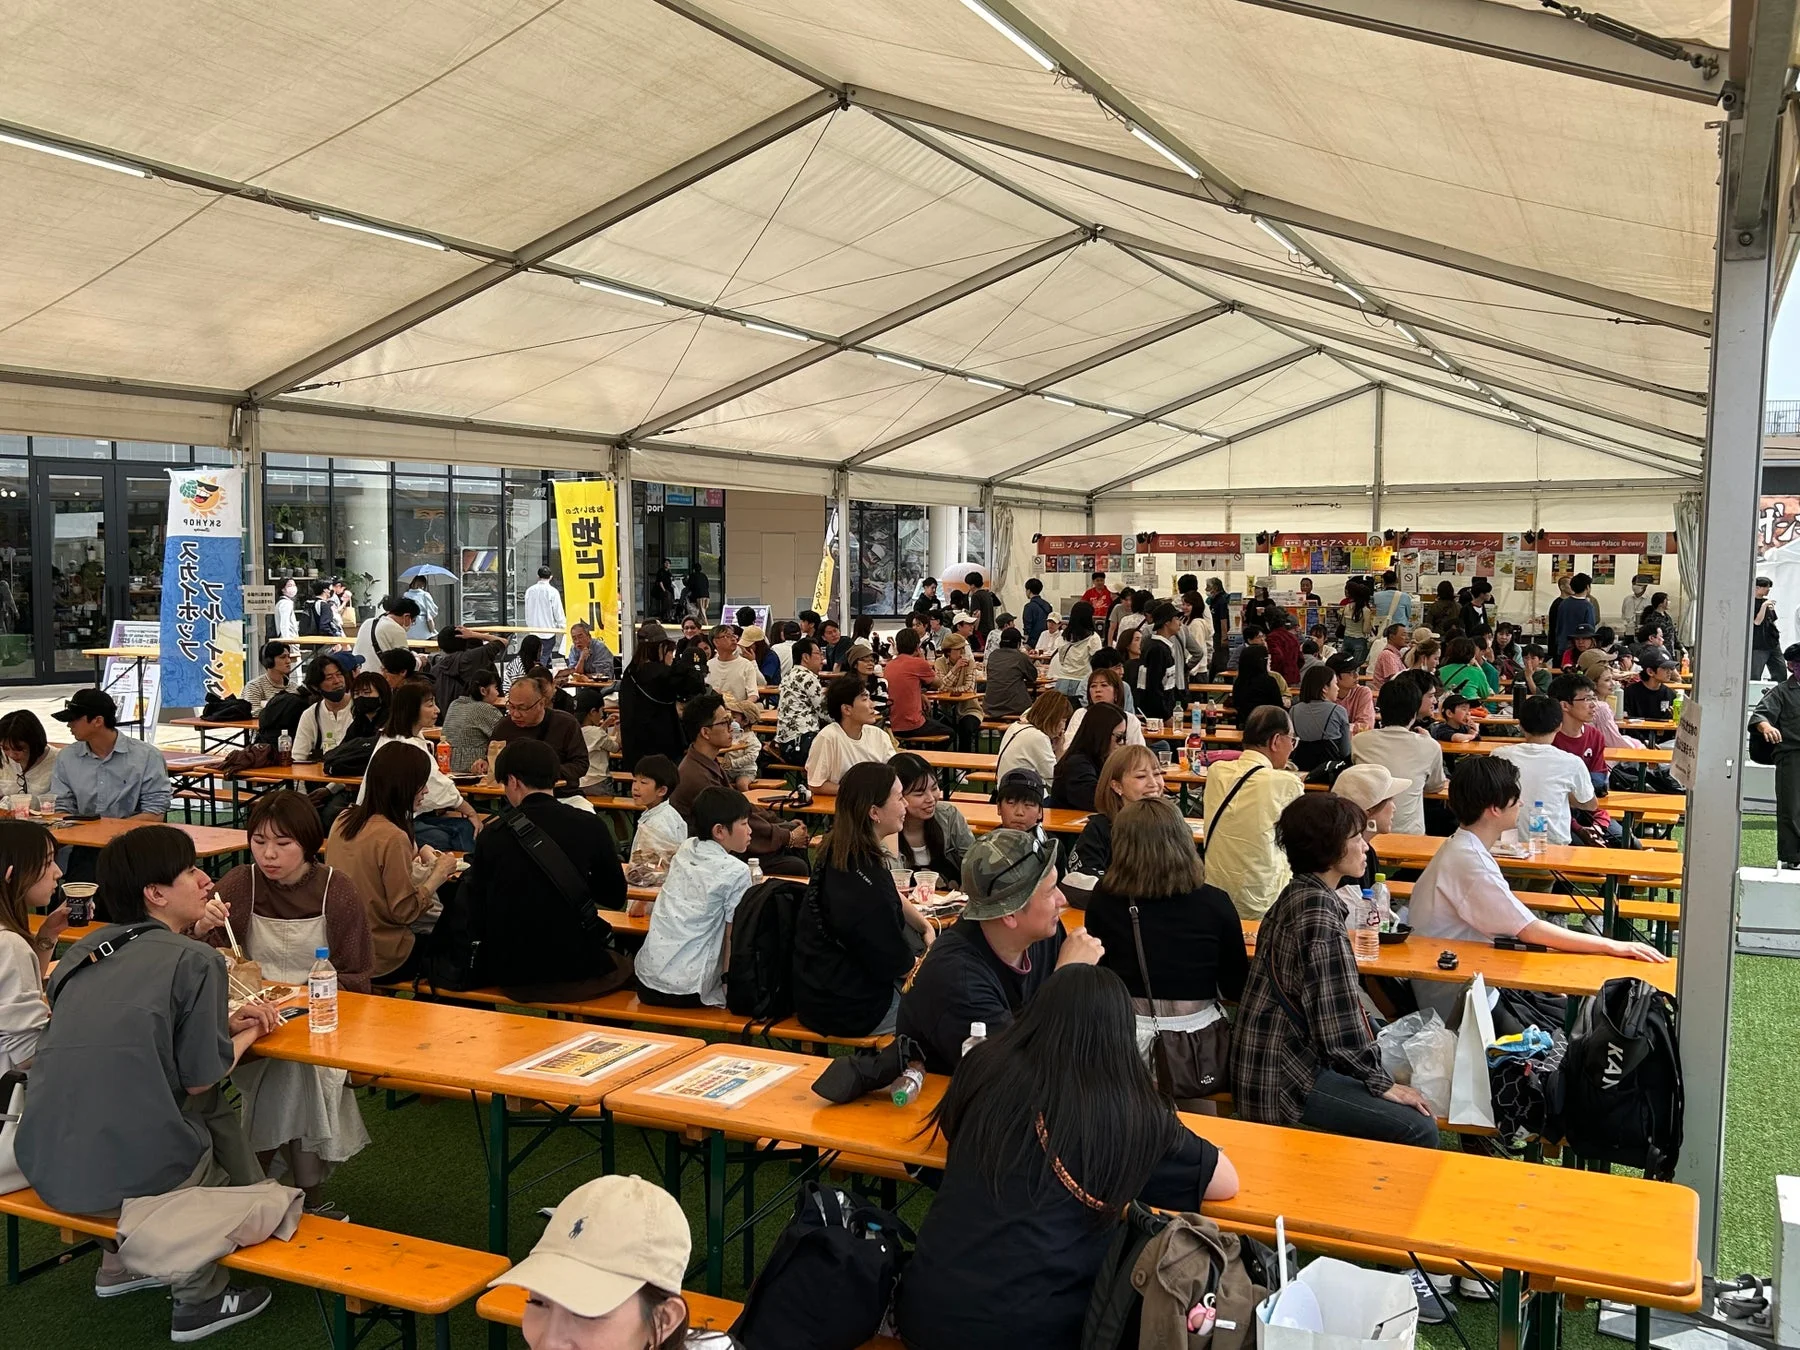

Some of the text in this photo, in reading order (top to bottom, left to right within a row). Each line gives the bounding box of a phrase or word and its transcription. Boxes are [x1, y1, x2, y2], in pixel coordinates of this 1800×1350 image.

[647, 504, 664, 514] port
[1621, 540, 1645, 548] Brewery
[220, 1295, 240, 1314] N
